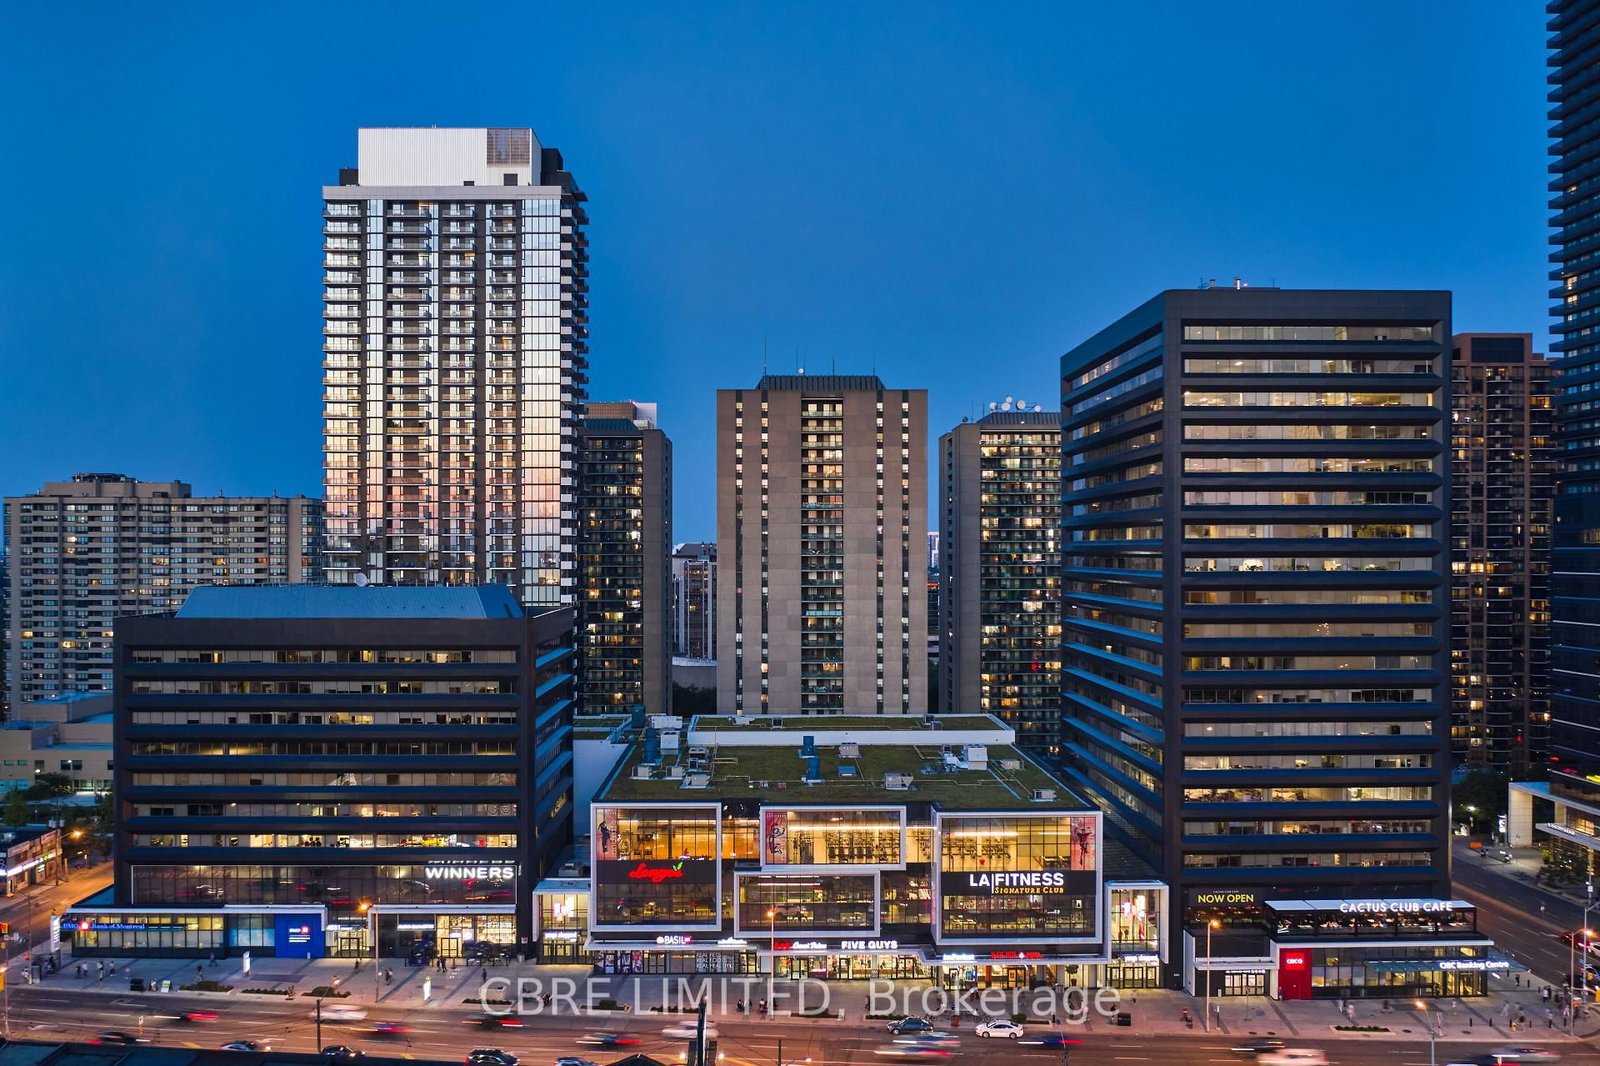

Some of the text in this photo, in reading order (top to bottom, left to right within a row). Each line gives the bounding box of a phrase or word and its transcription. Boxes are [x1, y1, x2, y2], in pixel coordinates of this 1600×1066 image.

[425, 867, 514, 879] WINNERS
[969, 872, 1064, 887] LA FITNESS
[994, 886, 1064, 894] SIGNATURE CLUB
[1197, 894, 1254, 903] NOW OPEN
[1340, 901, 1453, 913] CACTUS CLUB CAFE
[664, 936, 685, 944] BASIL
[841, 940, 898, 950] FIVE GUYS
[1457, 962, 1484, 970] Banking
